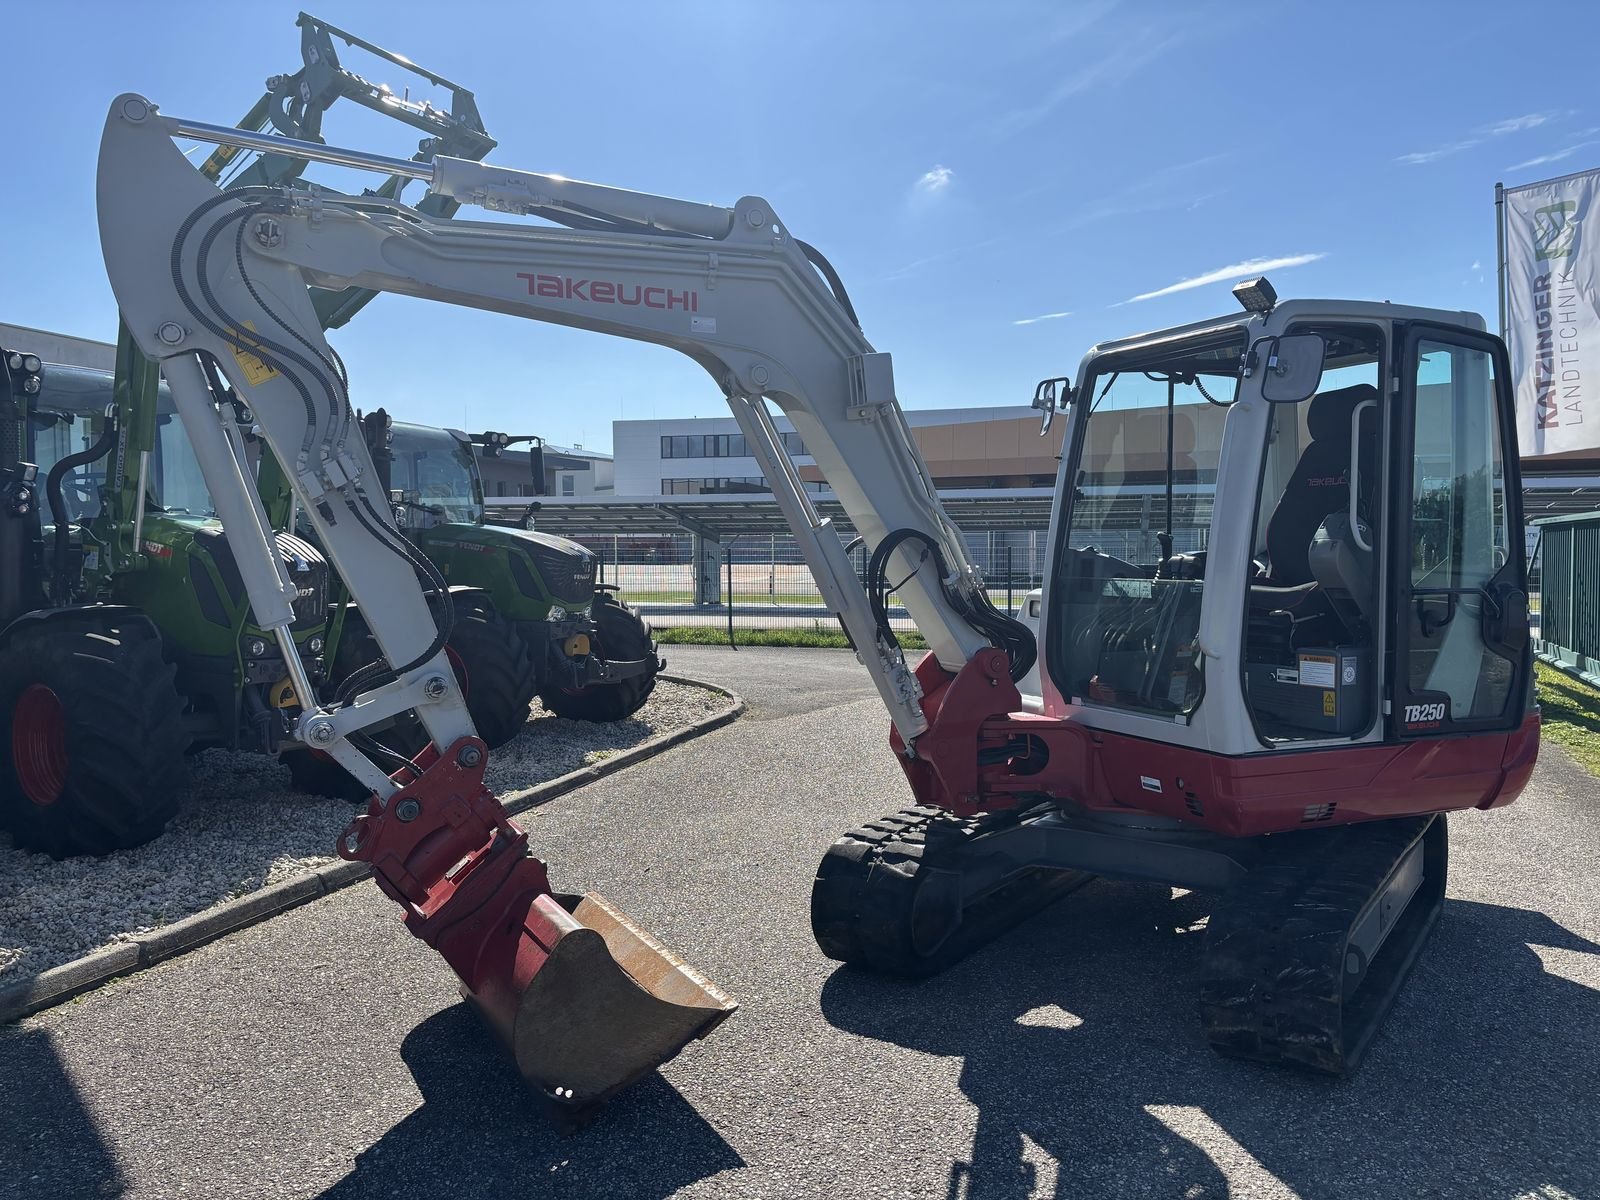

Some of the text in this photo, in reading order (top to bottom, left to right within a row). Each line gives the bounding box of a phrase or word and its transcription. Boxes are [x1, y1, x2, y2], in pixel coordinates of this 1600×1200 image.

[516, 272, 698, 312] TAKEUCHI
[1533, 271, 1560, 430] KATZINGER
[1558, 269, 1584, 426] LANDTECHNIK
[1404, 703, 1445, 723] TB250
